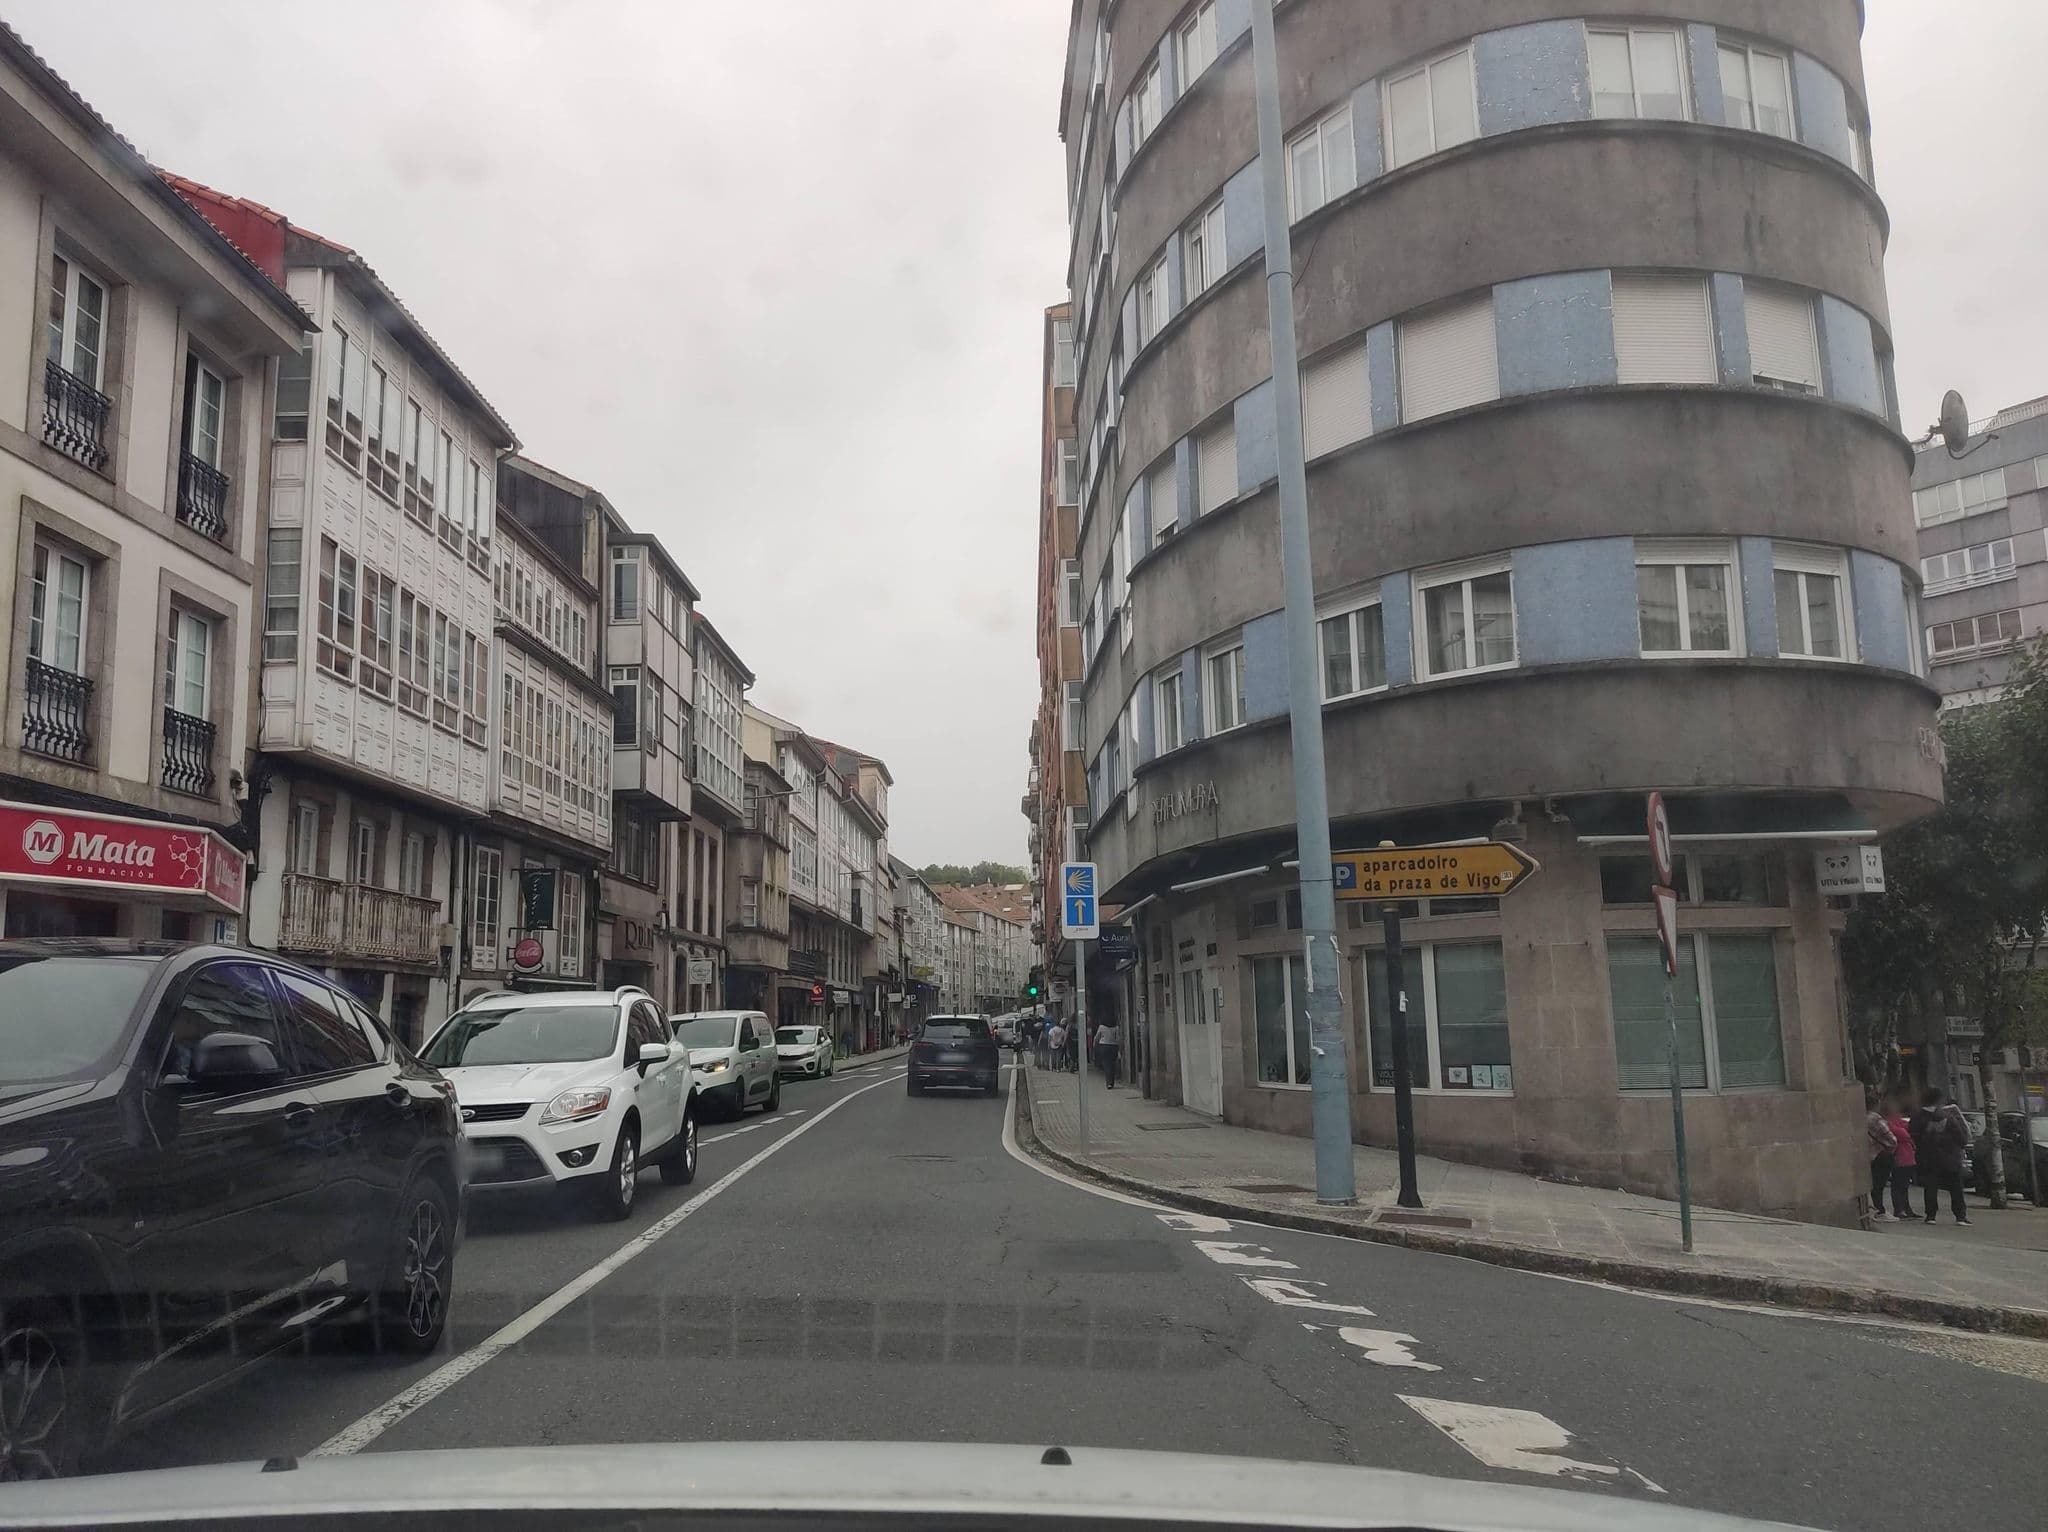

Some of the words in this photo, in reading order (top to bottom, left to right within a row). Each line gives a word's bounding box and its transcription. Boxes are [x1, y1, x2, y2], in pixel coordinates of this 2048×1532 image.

[68, 831, 155, 867] Mata
[66, 864, 154, 879] FORMACIÓN
[1363, 857, 1458, 875] aparcadoiro
[1364, 875, 1381, 892] da
[1389, 877, 1431, 894] praza
[1440, 874, 1458, 889] de
[1467, 871, 1501, 891] Vigo
